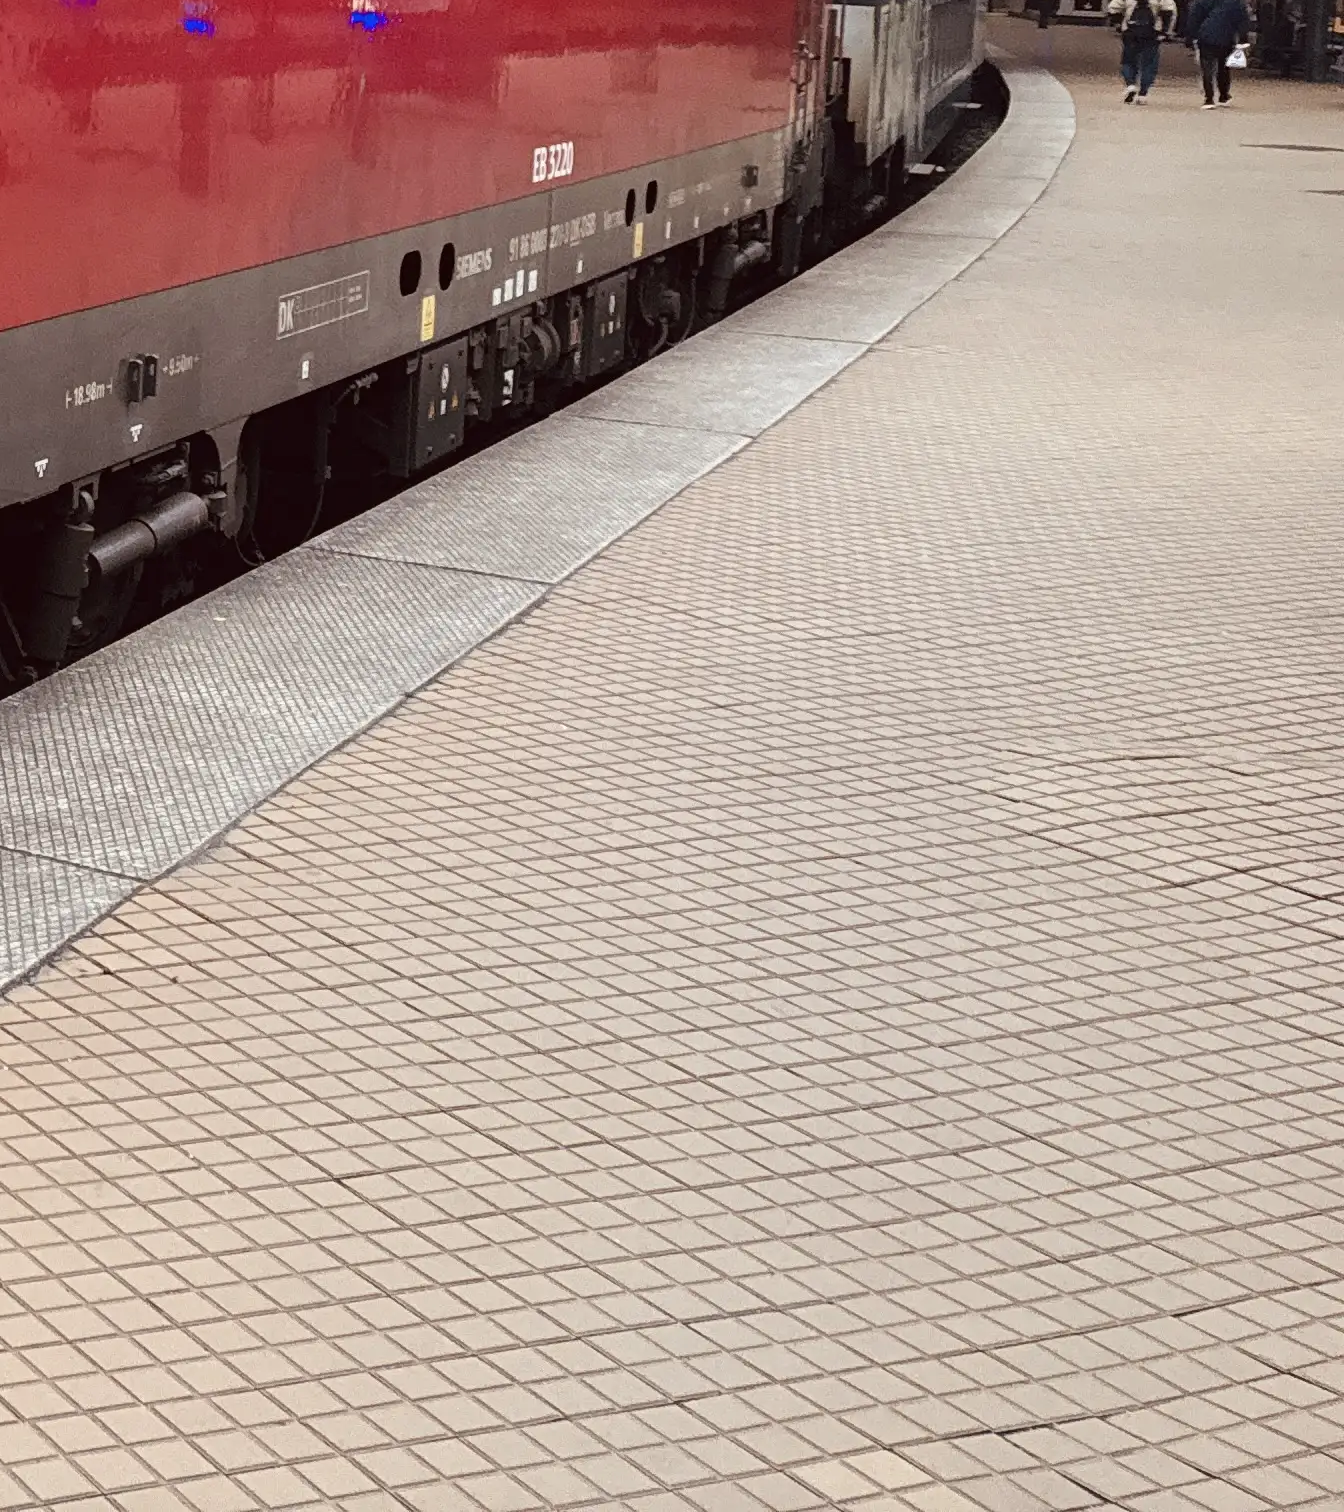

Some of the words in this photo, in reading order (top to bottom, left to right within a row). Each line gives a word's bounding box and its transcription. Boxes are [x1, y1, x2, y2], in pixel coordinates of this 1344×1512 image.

[532, 146, 547, 183] EB
[547, 141, 574, 180] 3220
[278, 298, 295, 334] DK
